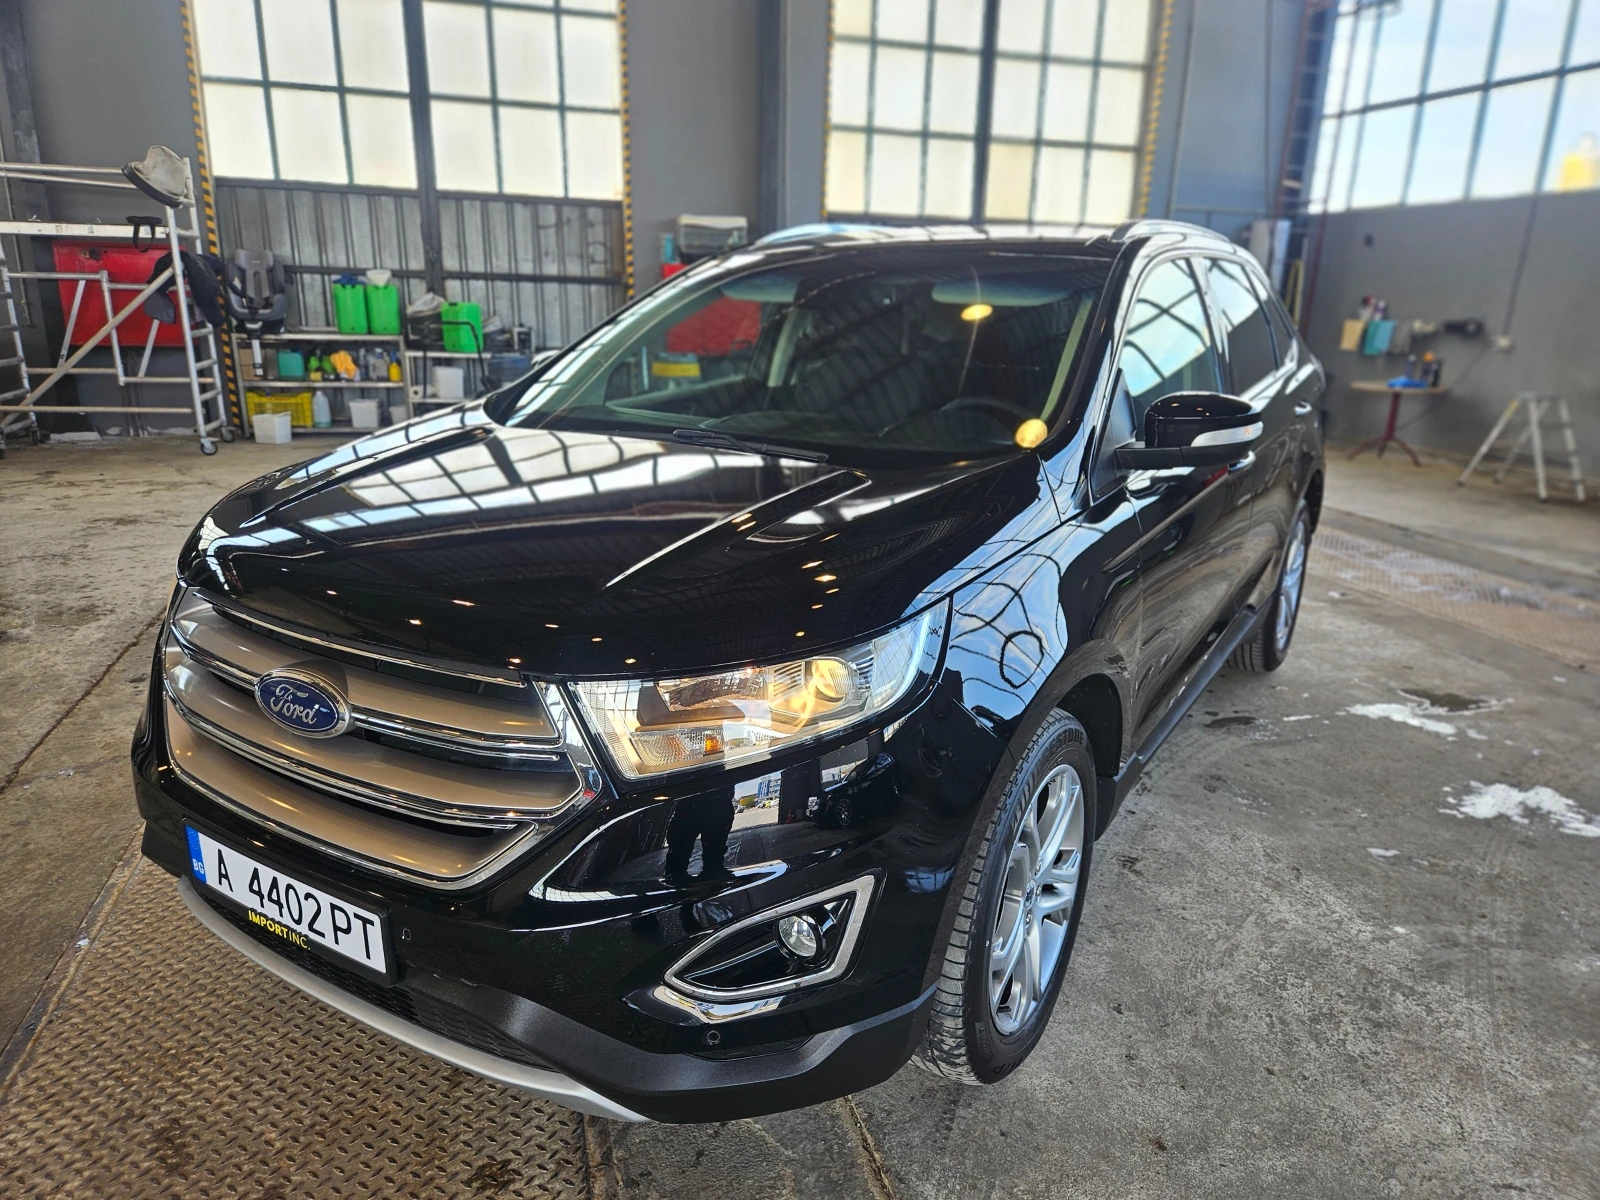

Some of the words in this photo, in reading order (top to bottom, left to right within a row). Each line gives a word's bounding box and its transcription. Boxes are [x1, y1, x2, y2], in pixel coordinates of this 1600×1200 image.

[270, 684, 320, 725] Ford
[192, 858, 205, 875] BG
[217, 848, 234, 893] A
